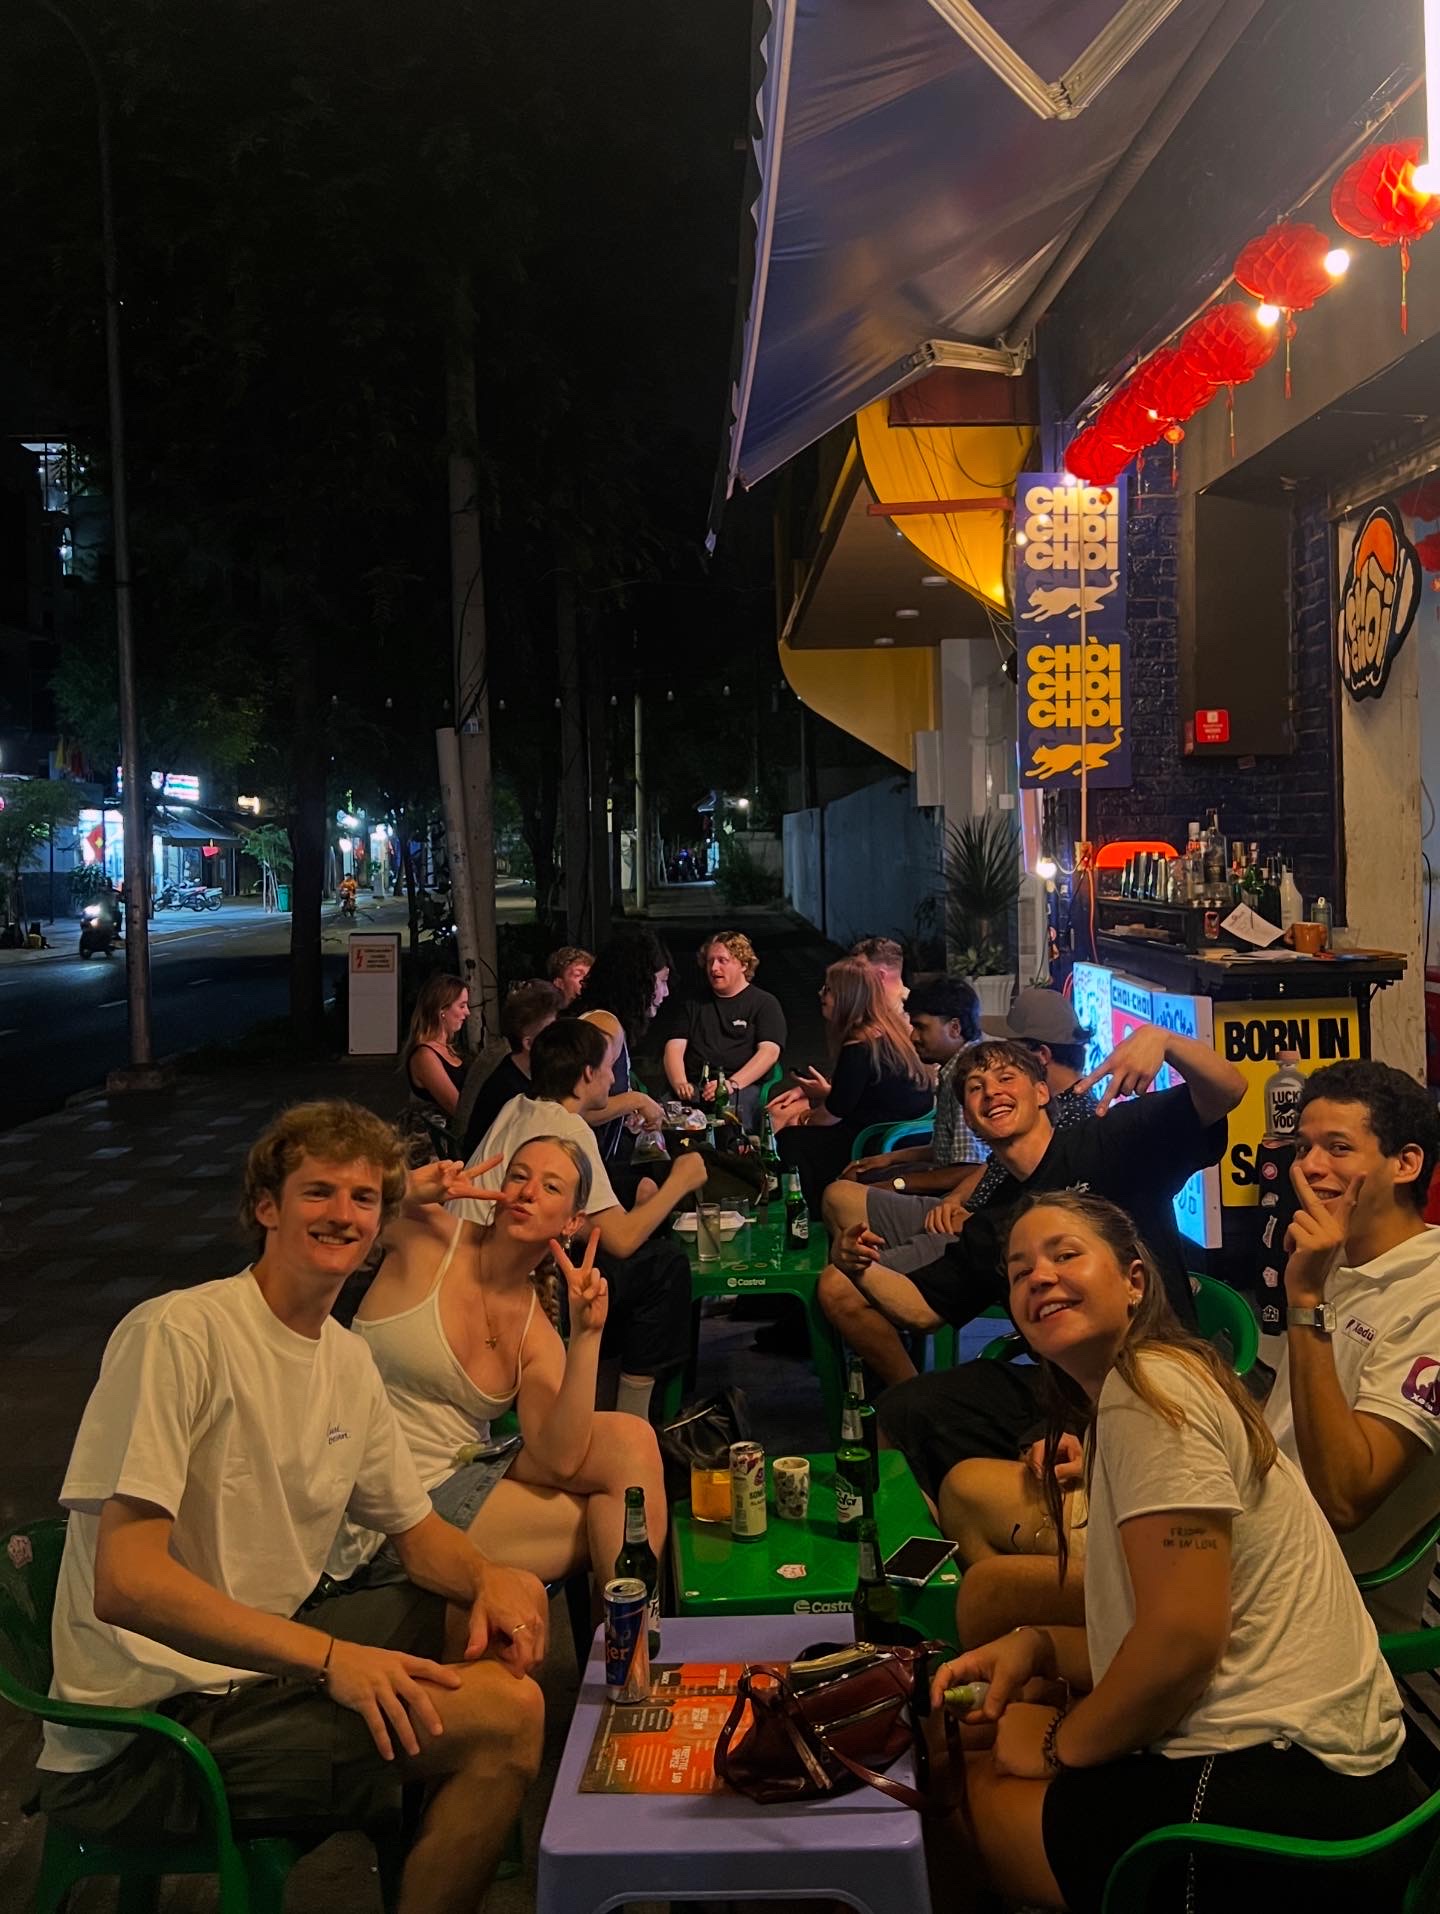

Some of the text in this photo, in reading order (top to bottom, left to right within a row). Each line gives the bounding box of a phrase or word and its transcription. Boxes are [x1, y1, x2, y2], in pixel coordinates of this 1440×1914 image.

[1025, 515, 1118, 541] CHOI
[1025, 543, 1118, 570] CHOI
[1027, 672, 1121, 700] CHOI
[1028, 700, 1121, 728] CHOI
[1224, 1018, 1350, 1062] BORN IN
[1272, 1091, 1298, 1104] LUCK
[1273, 1114, 1294, 1128] VOD
[738, 1278, 766, 1286] Castrol
